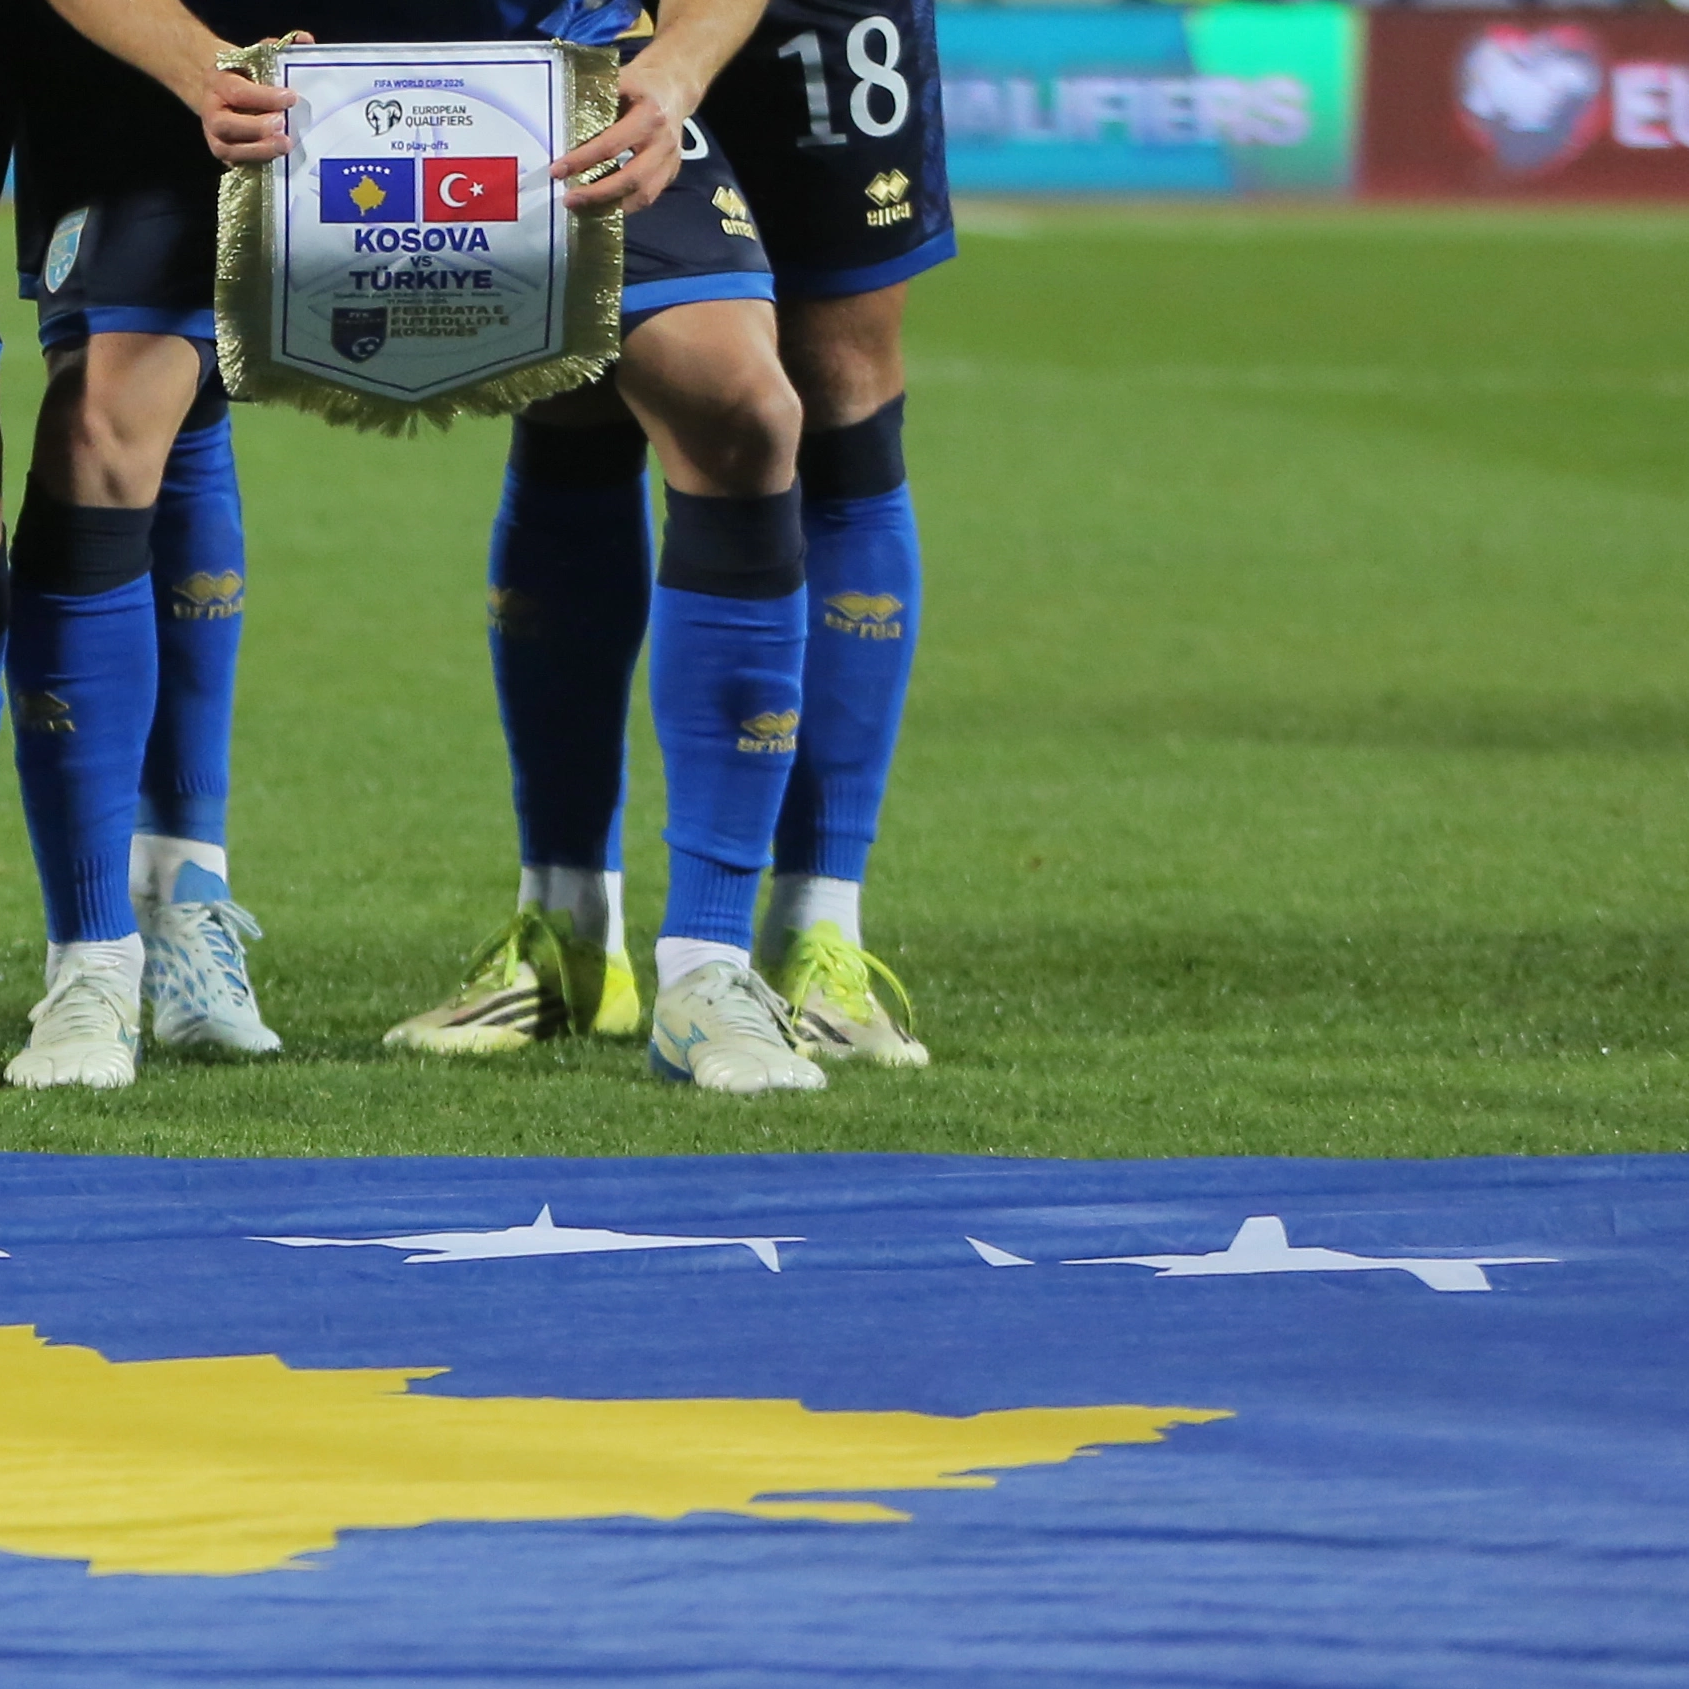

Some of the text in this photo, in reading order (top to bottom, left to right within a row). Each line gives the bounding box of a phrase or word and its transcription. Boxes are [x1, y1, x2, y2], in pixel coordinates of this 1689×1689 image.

[374, 78, 465, 88] FIFA WORLD CUP 2026
[778, 16, 909, 147] 18
[412, 105, 466, 115] EUROPEAN
[1611, 64, 1689, 148] E
[405, 115, 473, 128] QUALIFIERS
[391, 140, 449, 152] KO play-offs
[354, 227, 490, 253] KOSOVA
[349, 265, 493, 291] TÜRKIYE
[391, 305, 489, 316] FEDERATA
